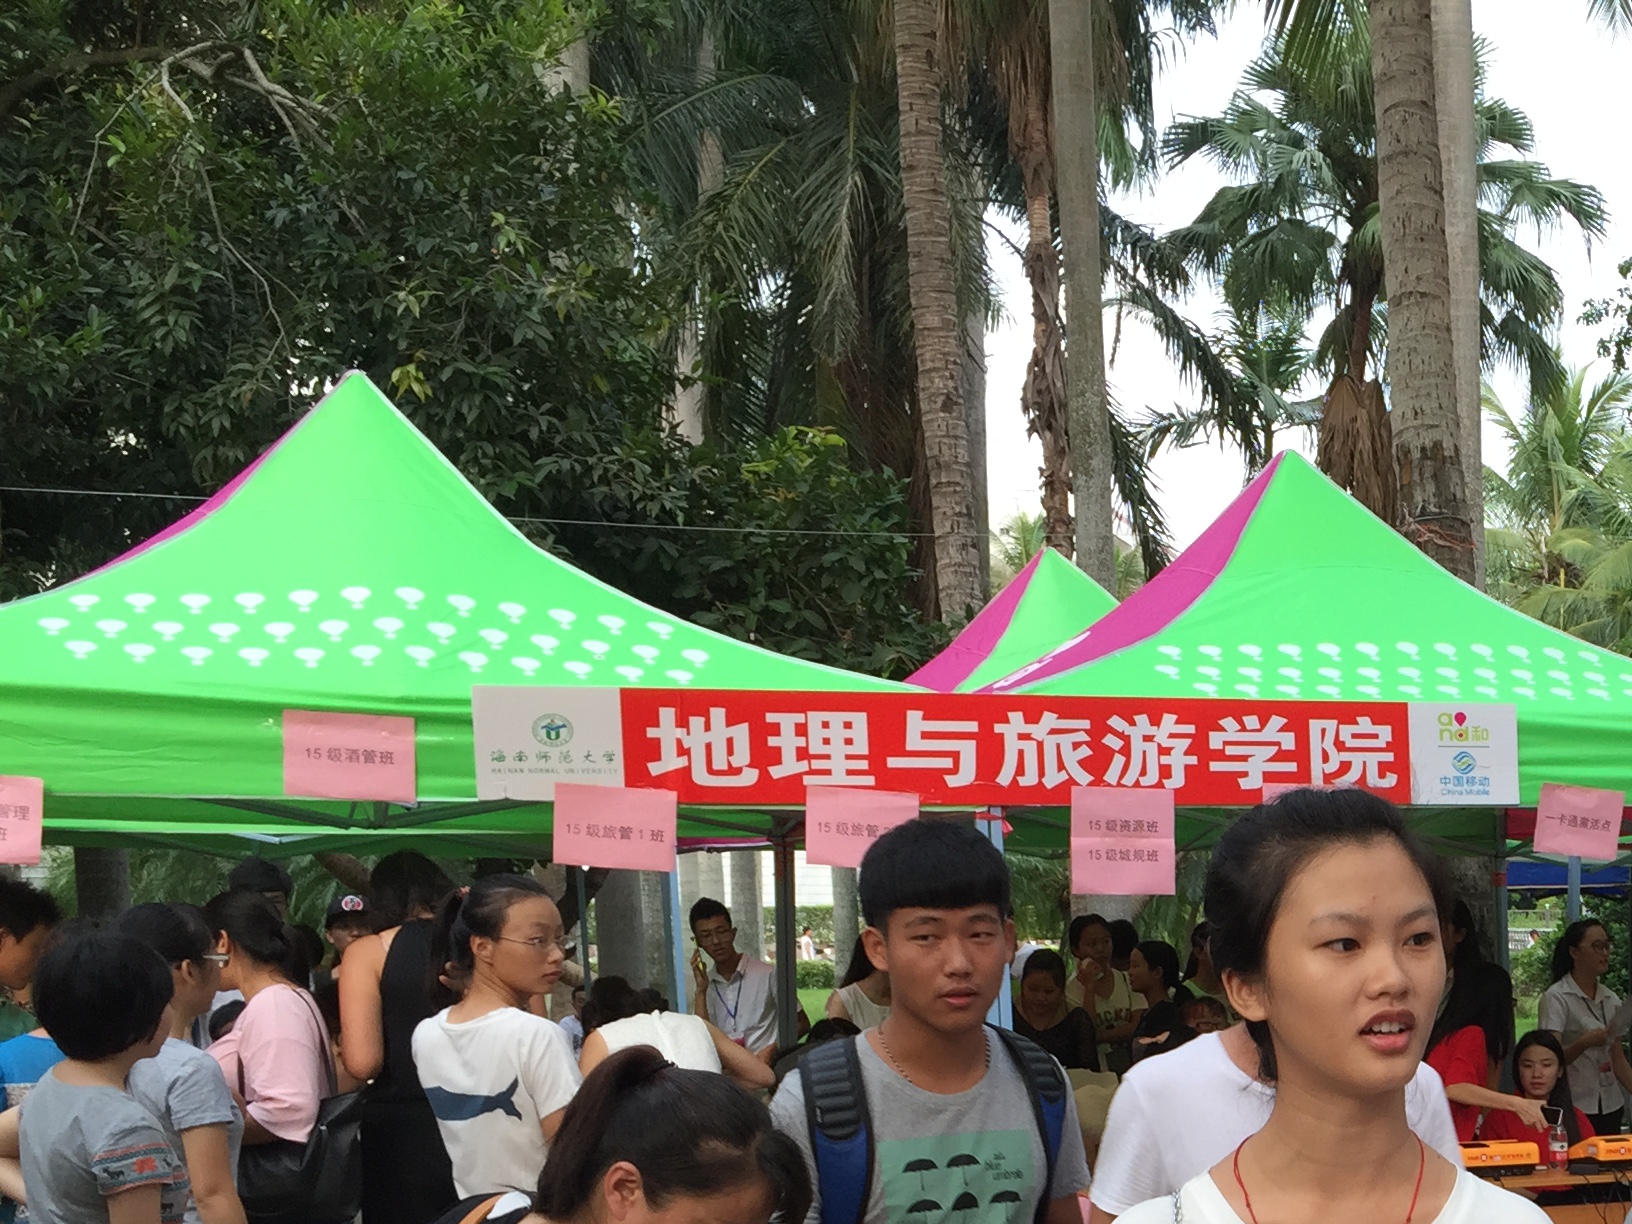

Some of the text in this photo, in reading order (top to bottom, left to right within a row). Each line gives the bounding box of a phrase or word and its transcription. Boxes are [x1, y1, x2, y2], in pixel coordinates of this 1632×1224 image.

[645, 706, 1399, 789] 地理与旅游学院
[490, 749, 616, 764] 海南师范大学
[1440, 776, 1490, 787] 中国移动
